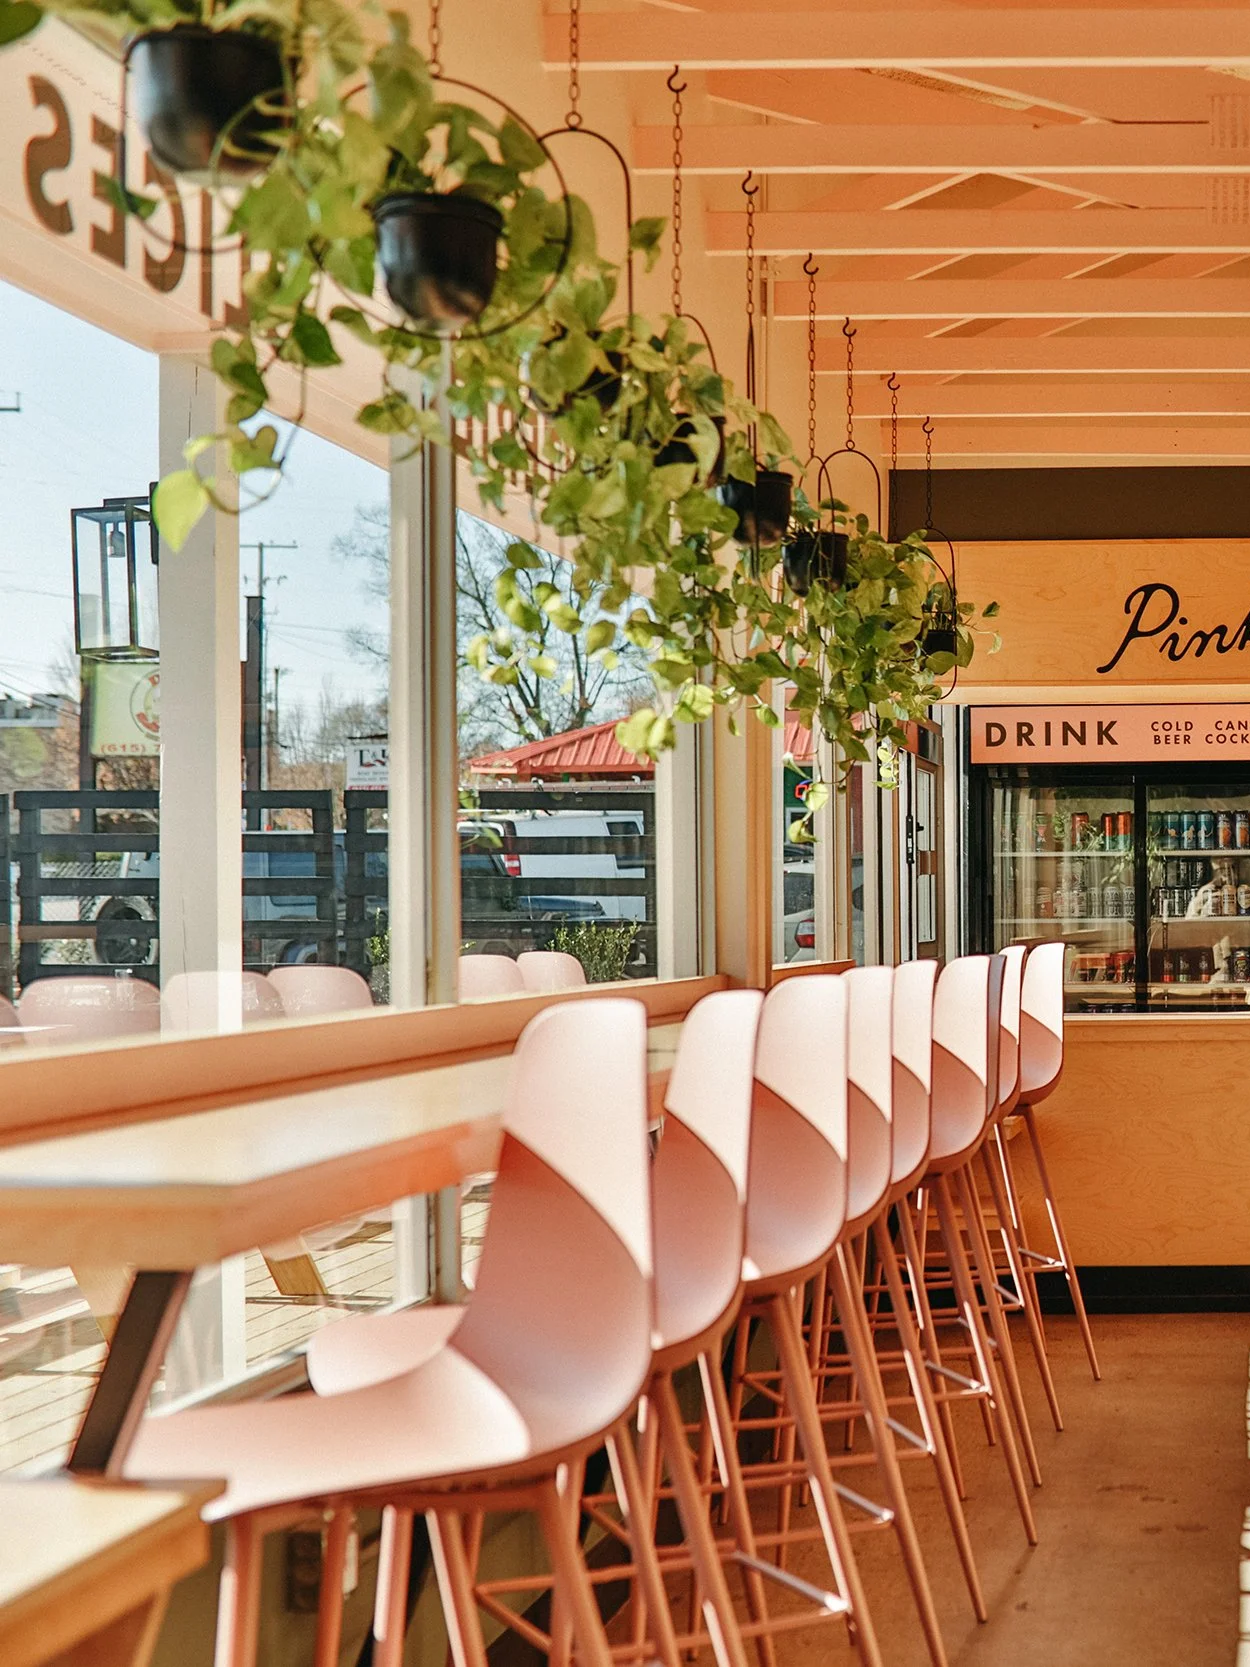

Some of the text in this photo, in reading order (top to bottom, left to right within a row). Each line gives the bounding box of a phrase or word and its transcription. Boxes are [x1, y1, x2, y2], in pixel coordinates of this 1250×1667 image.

[1150, 720, 1194, 733] COLD
[985, 720, 1120, 747] DRINK
[1153, 733, 1192, 746] BEER
